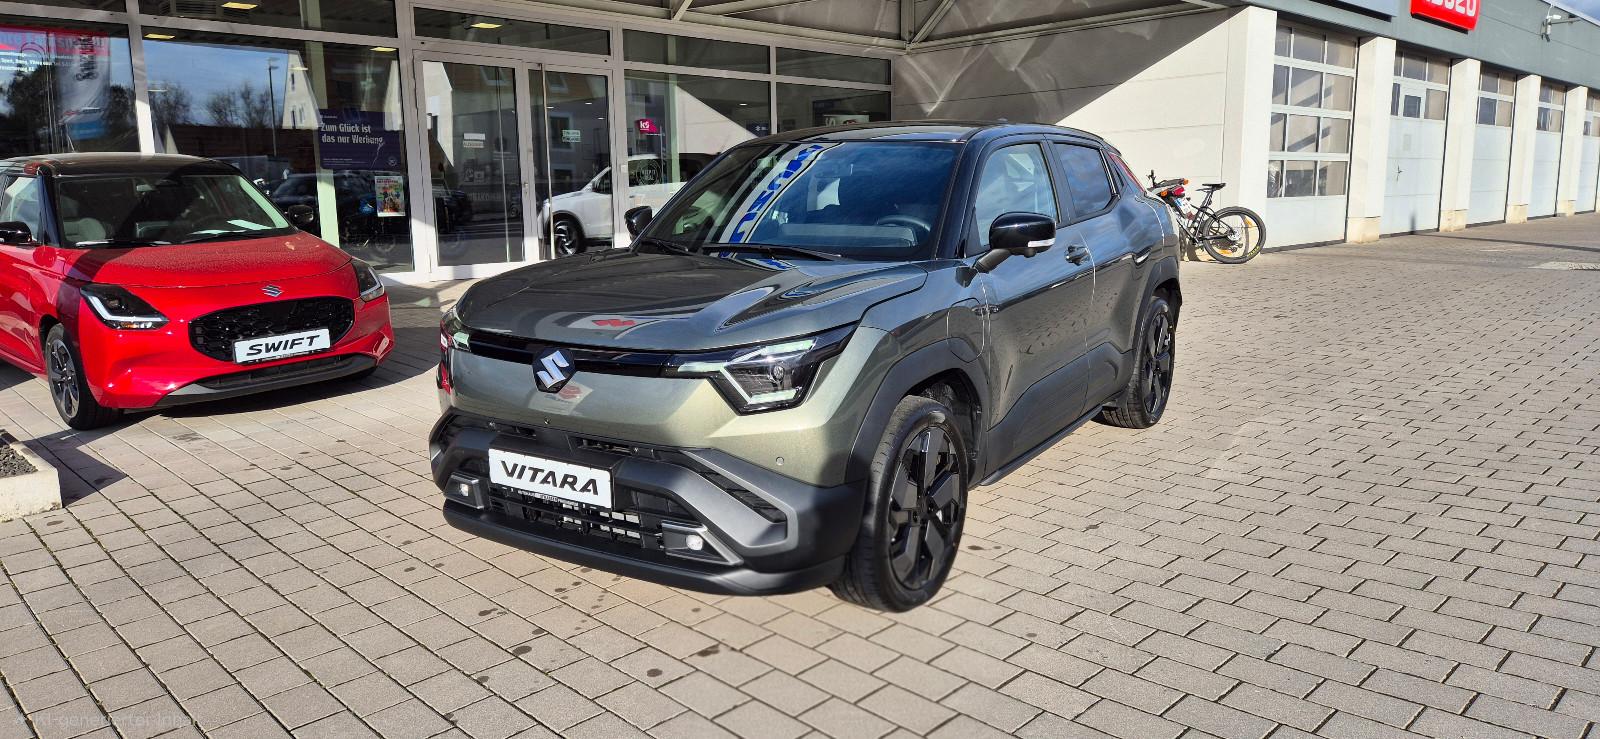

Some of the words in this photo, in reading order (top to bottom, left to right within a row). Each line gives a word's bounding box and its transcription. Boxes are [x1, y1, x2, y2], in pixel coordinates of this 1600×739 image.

[321, 122, 337, 132] Zum
[339, 123, 360, 133] Glück
[361, 123, 371, 133] ist
[321, 133, 336, 143] das
[337, 136, 350, 144] nur
[246, 335, 320, 356] SWIFT
[501, 460, 598, 495] VITARA
